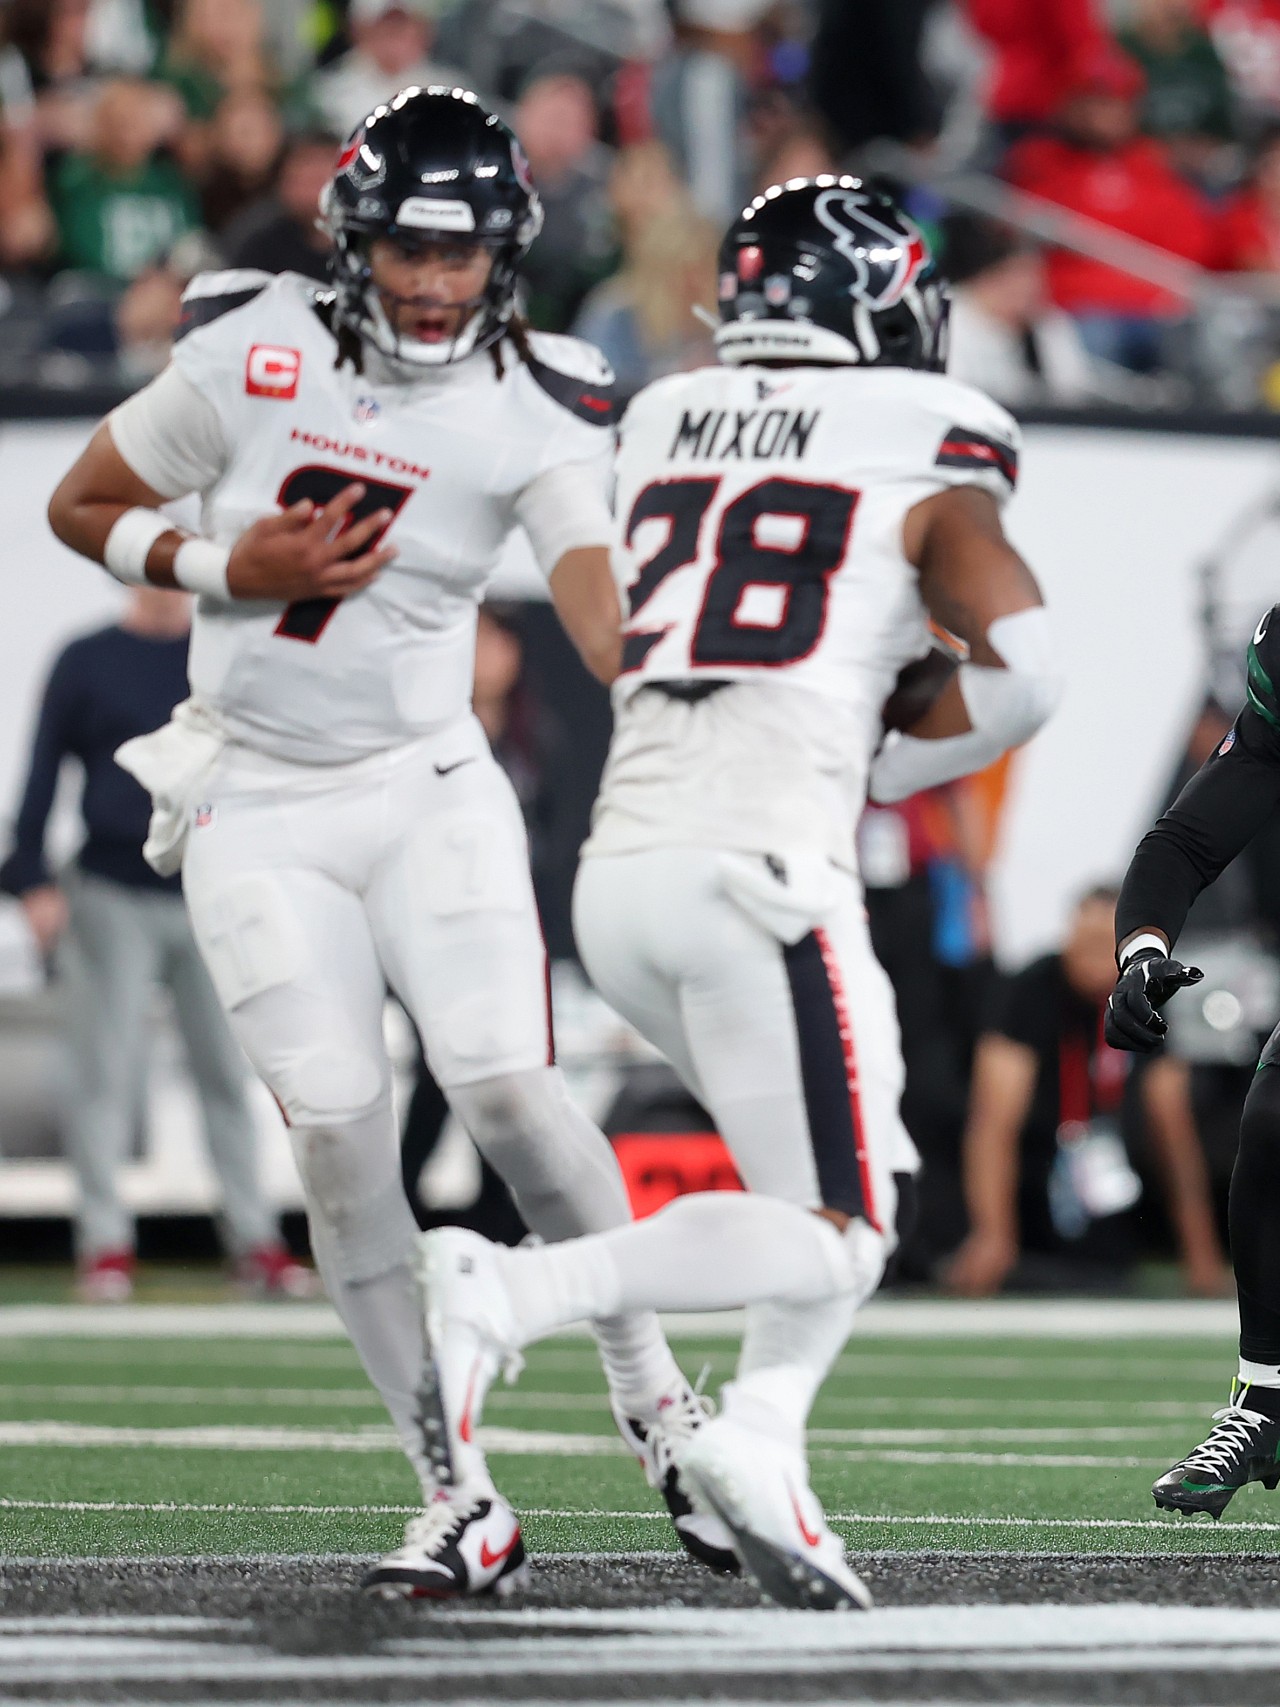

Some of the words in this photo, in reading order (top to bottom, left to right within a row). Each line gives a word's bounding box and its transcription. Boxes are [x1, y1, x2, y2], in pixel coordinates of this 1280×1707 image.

[250, 348, 299, 389] C
[290, 427, 431, 480] HOUSTON
[668, 409, 822, 460] MIXON
[272, 461, 417, 646] 7
[620, 473, 863, 673] 28
